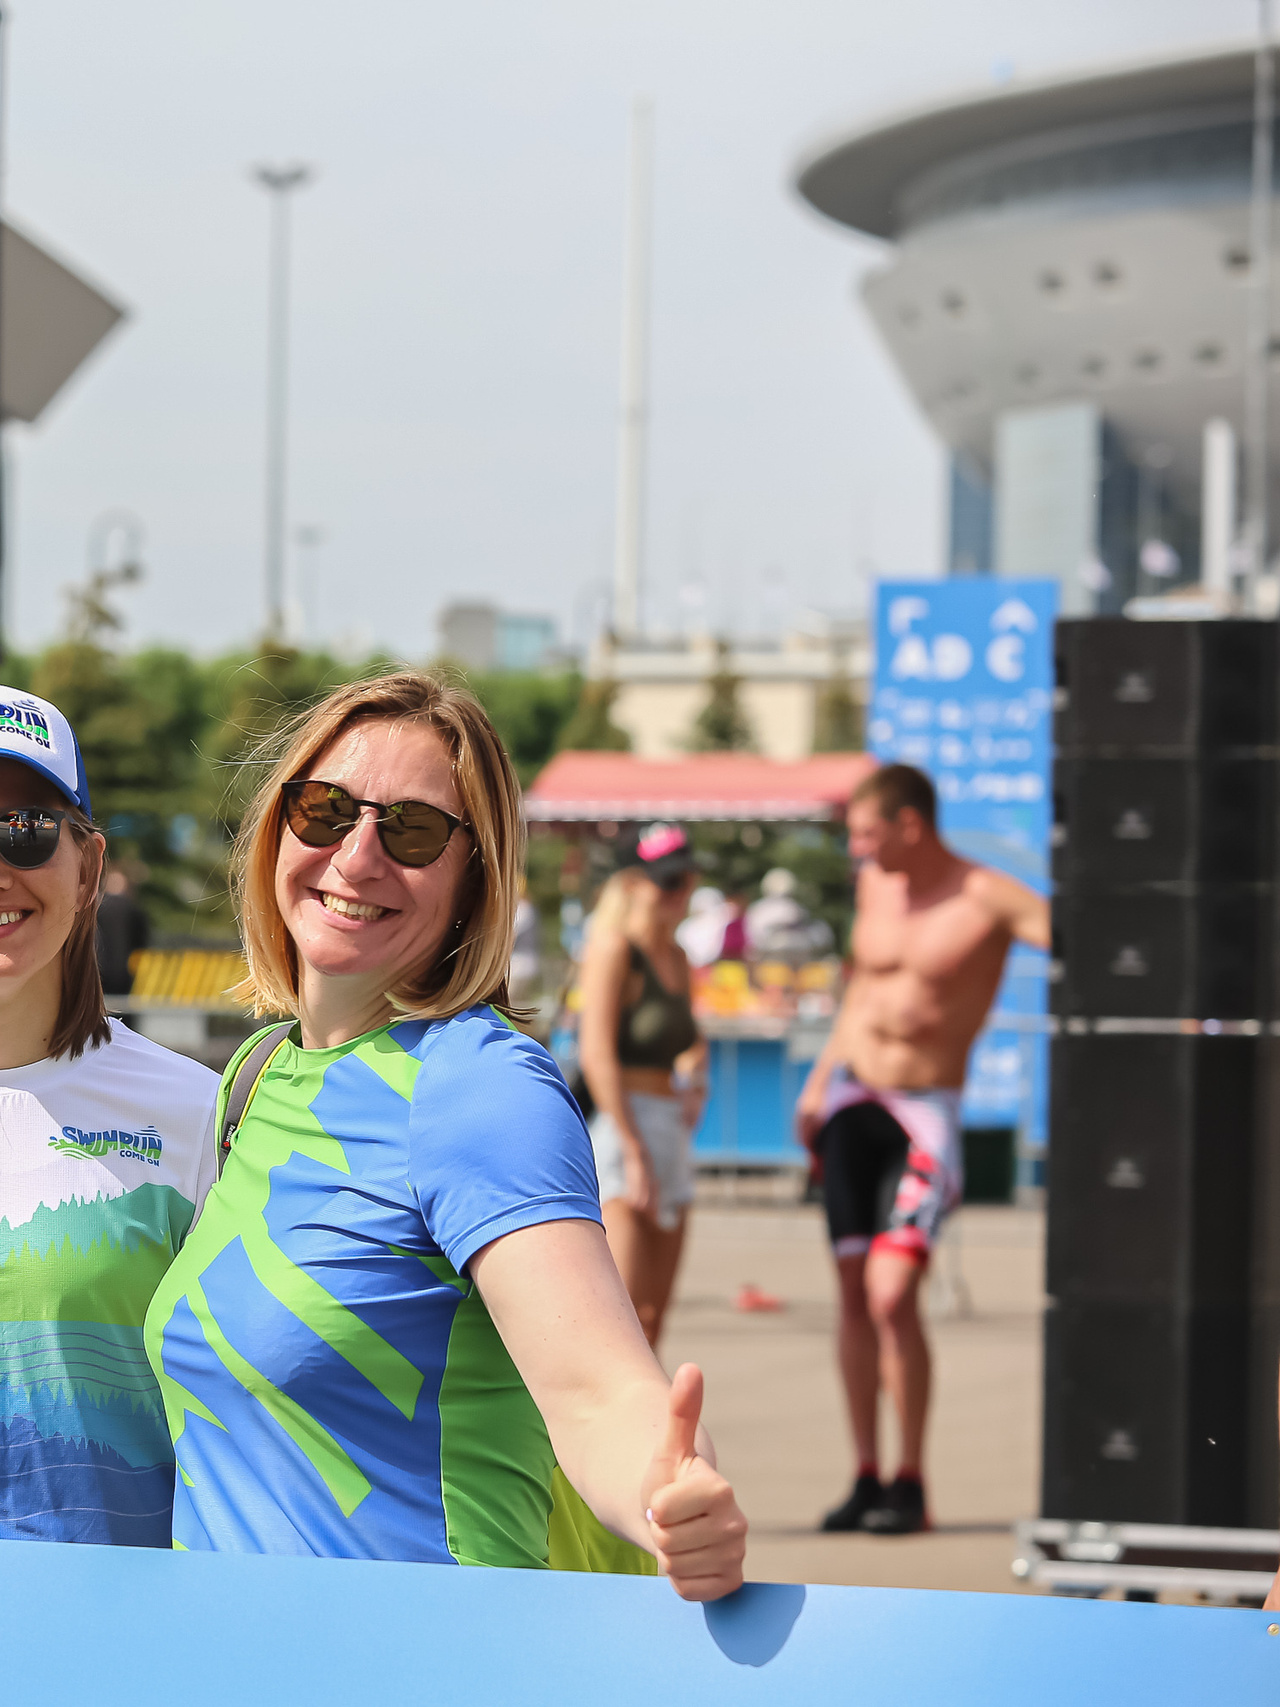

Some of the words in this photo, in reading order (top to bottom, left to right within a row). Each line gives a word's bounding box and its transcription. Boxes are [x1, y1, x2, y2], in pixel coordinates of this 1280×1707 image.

[35, 735, 50, 749] ON
[62, 1126, 162, 1160] SWIMRUN
[119, 1150, 145, 1162] COME
[147, 1158, 160, 1167] ON
